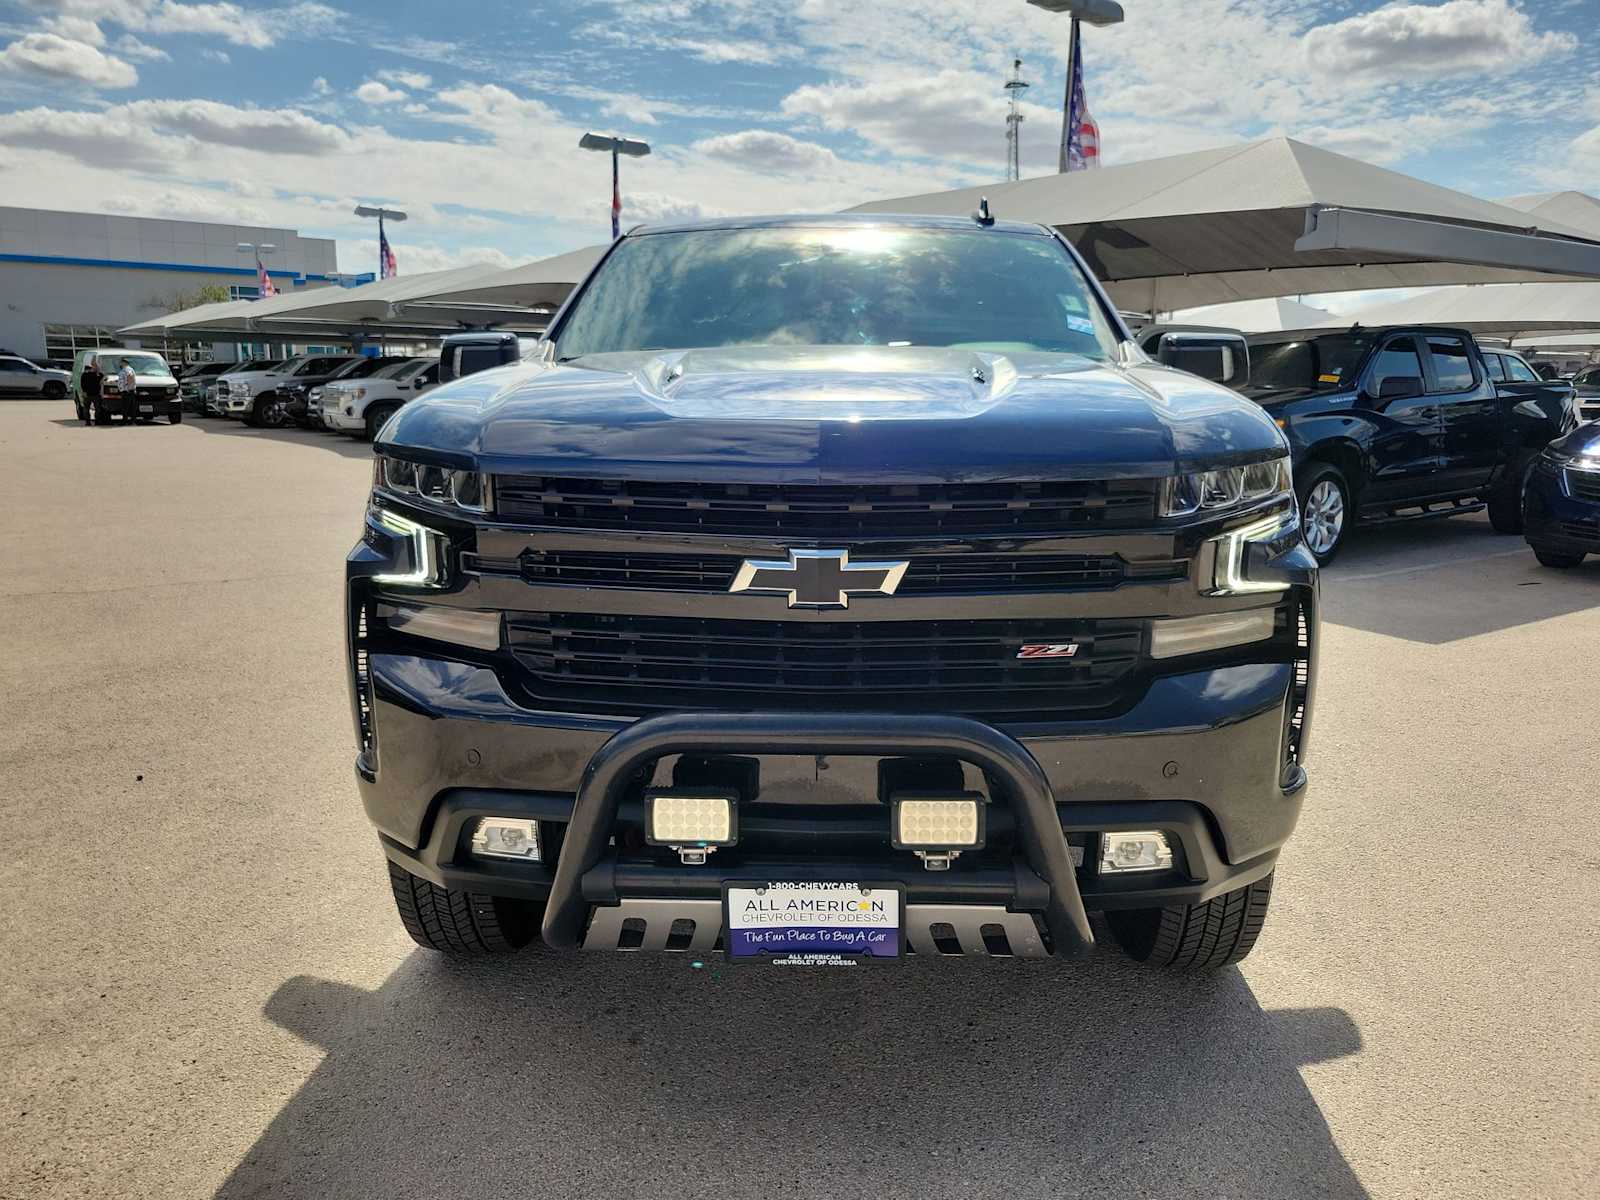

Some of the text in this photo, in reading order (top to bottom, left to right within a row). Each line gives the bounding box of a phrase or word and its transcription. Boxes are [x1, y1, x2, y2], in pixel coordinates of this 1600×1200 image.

[1016, 644, 1079, 659] Z71
[767, 882, 859, 890] 1-800-CHEVYCARS
[745, 900, 779, 911] ALL
[742, 913, 888, 923] CHEVROLET OF ODESSA
[743, 929, 887, 944] The Fun Place To Buy A Car
